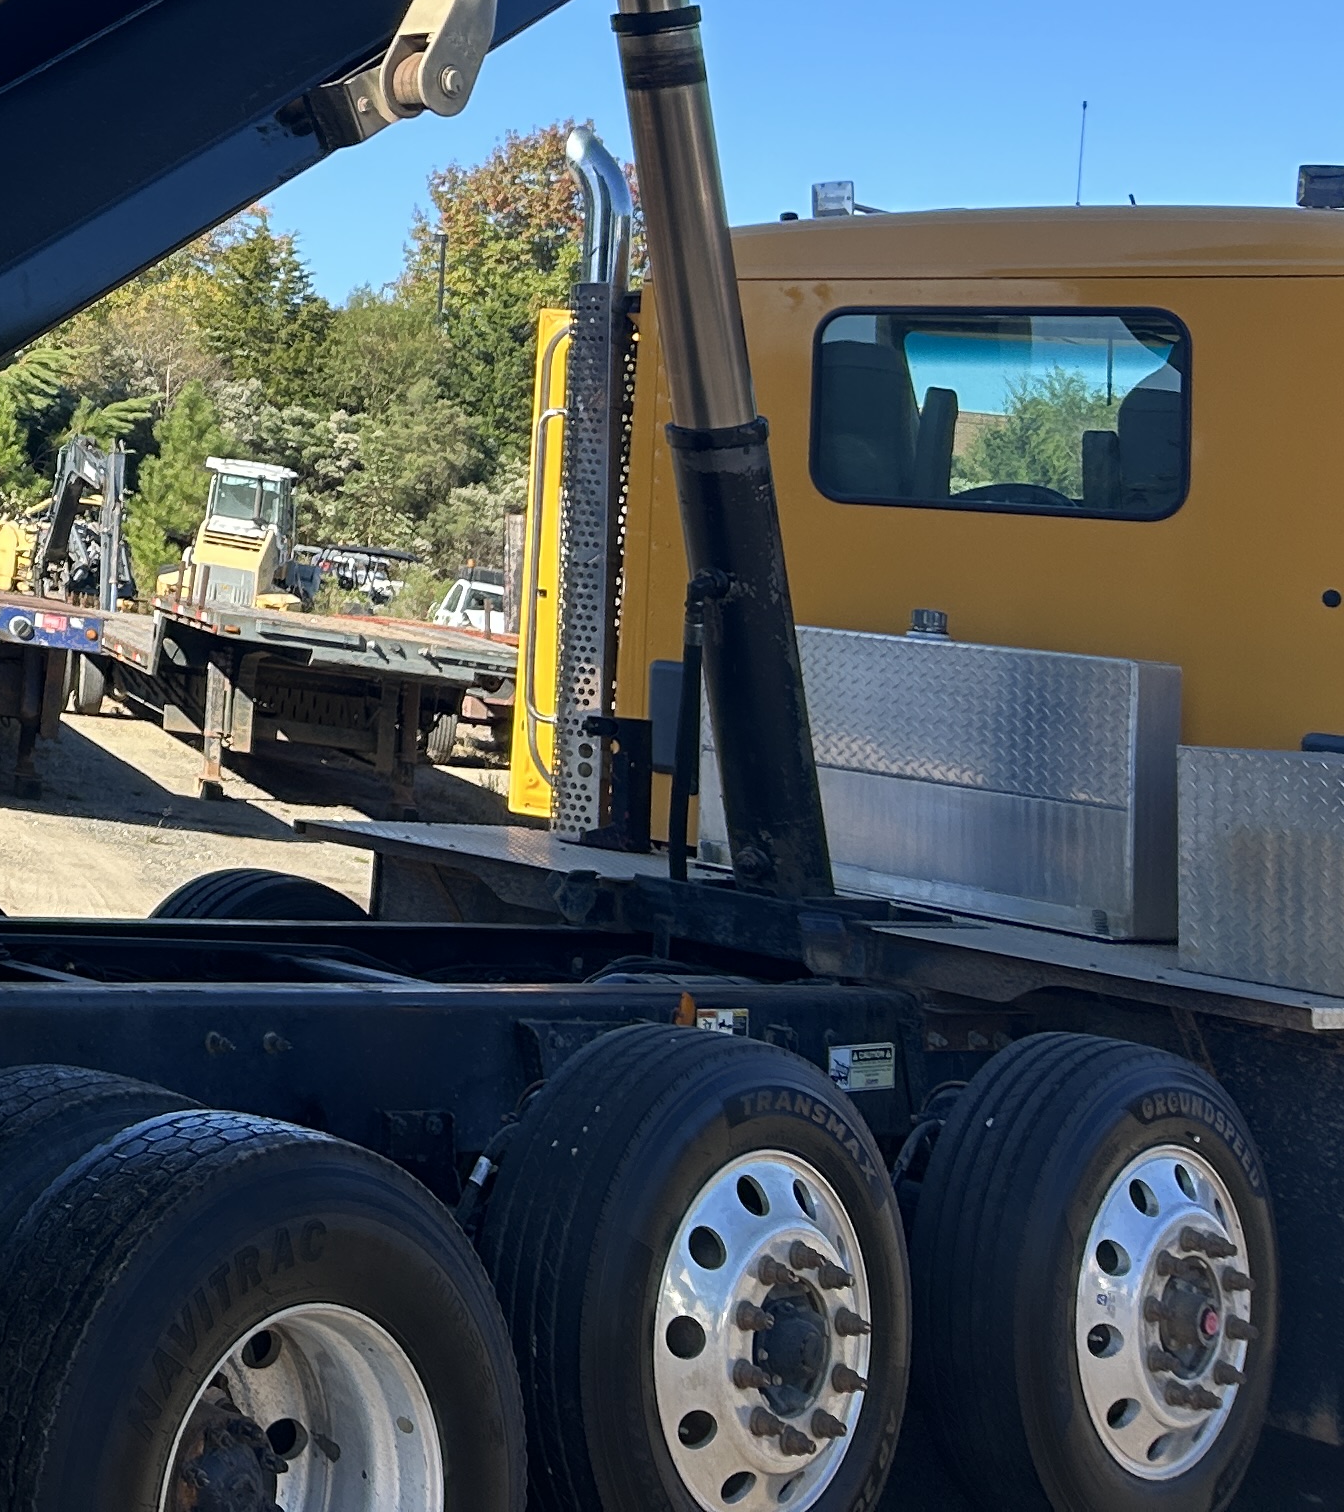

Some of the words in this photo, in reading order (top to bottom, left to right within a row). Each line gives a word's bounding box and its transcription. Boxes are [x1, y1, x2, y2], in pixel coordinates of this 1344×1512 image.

[740, 1090, 877, 1181] TRANSMAX
[1141, 1091, 1260, 1187] GROUNDSPEED
[125, 1218, 328, 1444] NAVITRAC
